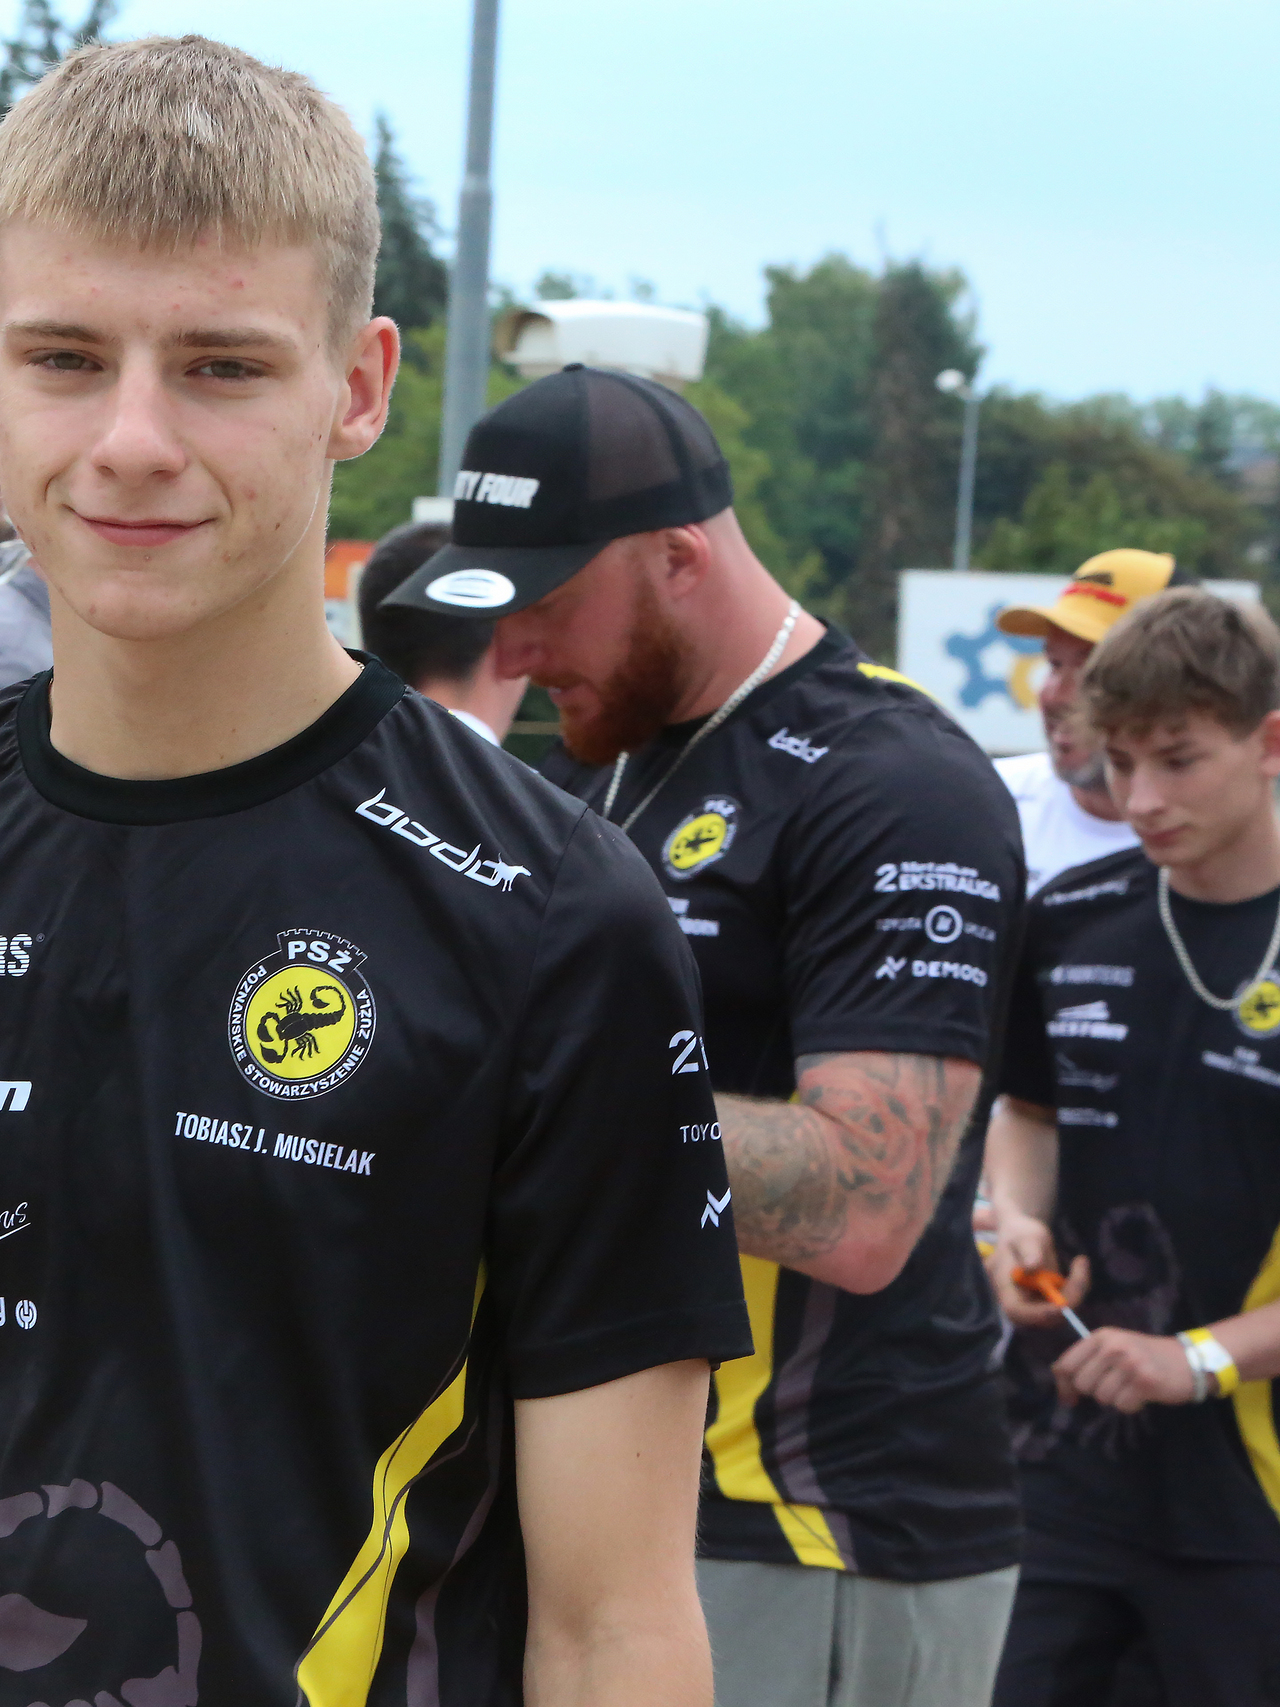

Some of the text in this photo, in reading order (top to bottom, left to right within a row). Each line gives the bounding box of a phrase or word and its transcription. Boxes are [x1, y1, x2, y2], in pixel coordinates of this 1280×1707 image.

[476, 473, 540, 509] FOUR
[874, 863, 898, 892] 2
[287, 940, 353, 973] PSŻ
[243, 1044, 366, 1097] STOWARZYSZENIE
[174, 1111, 376, 1176] TOBIASZ J. MUSIELAK
